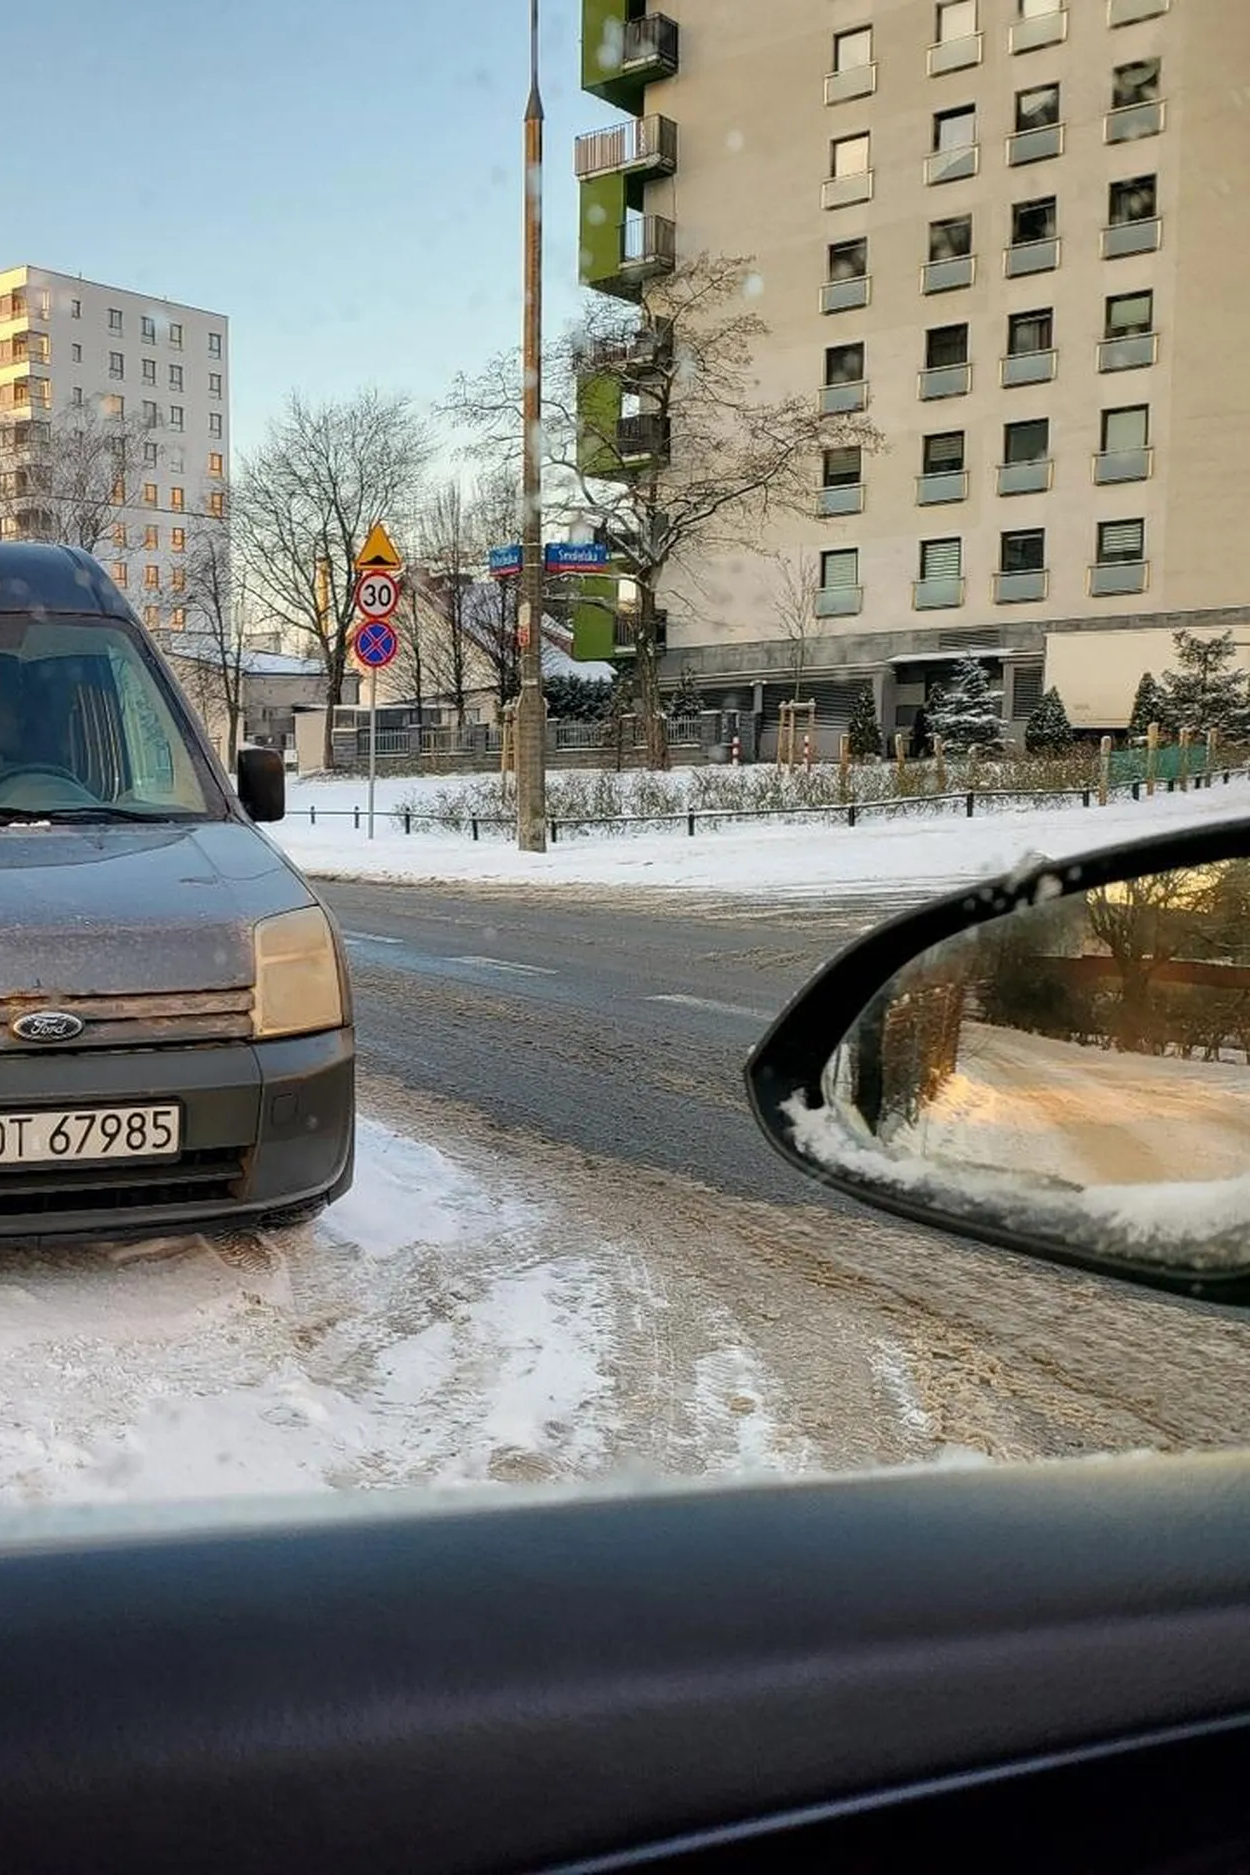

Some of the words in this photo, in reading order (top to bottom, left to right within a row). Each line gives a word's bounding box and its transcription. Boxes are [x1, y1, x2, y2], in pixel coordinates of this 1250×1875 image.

[363, 584, 392, 607] 30
[31, 1017, 67, 1035] Ford
[49, 1110, 172, 1155] 67985
